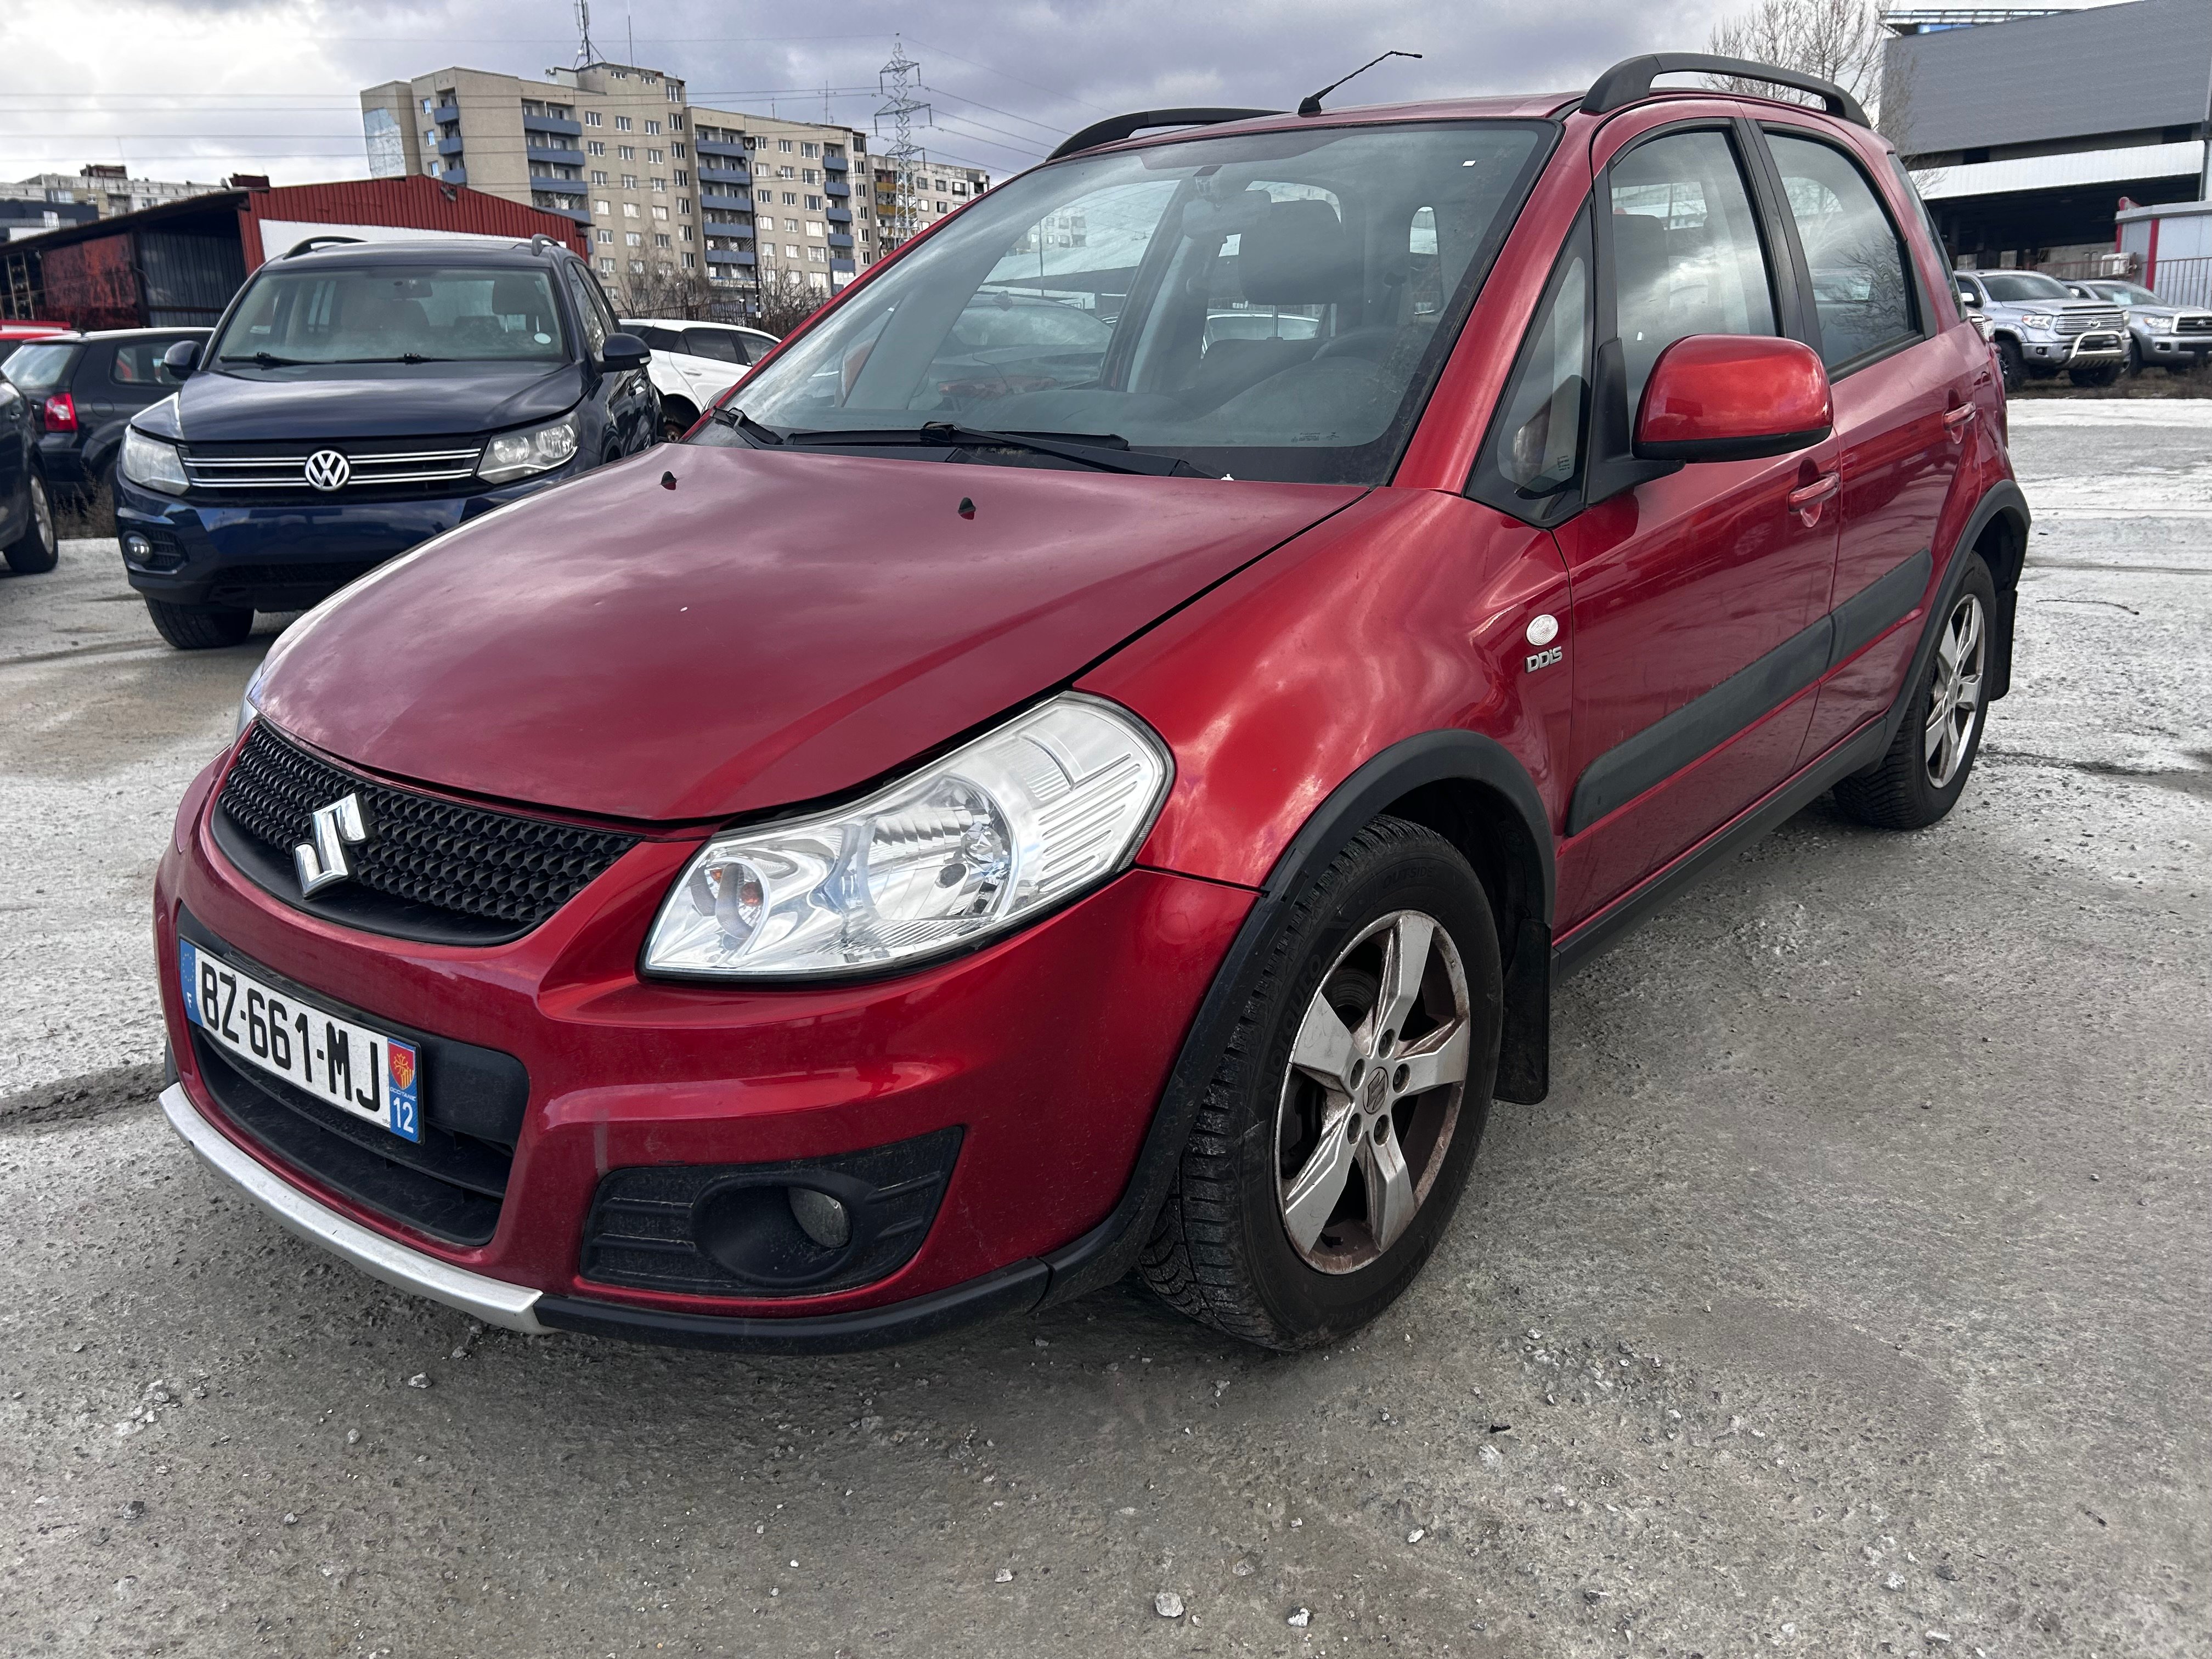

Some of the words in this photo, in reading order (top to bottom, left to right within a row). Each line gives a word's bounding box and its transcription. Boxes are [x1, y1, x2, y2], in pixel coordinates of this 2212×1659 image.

[201, 961, 381, 1113] BZ-661-MJ
[1260, 954, 1322, 1102] Norauto
[393, 1097, 414, 1134] 12
